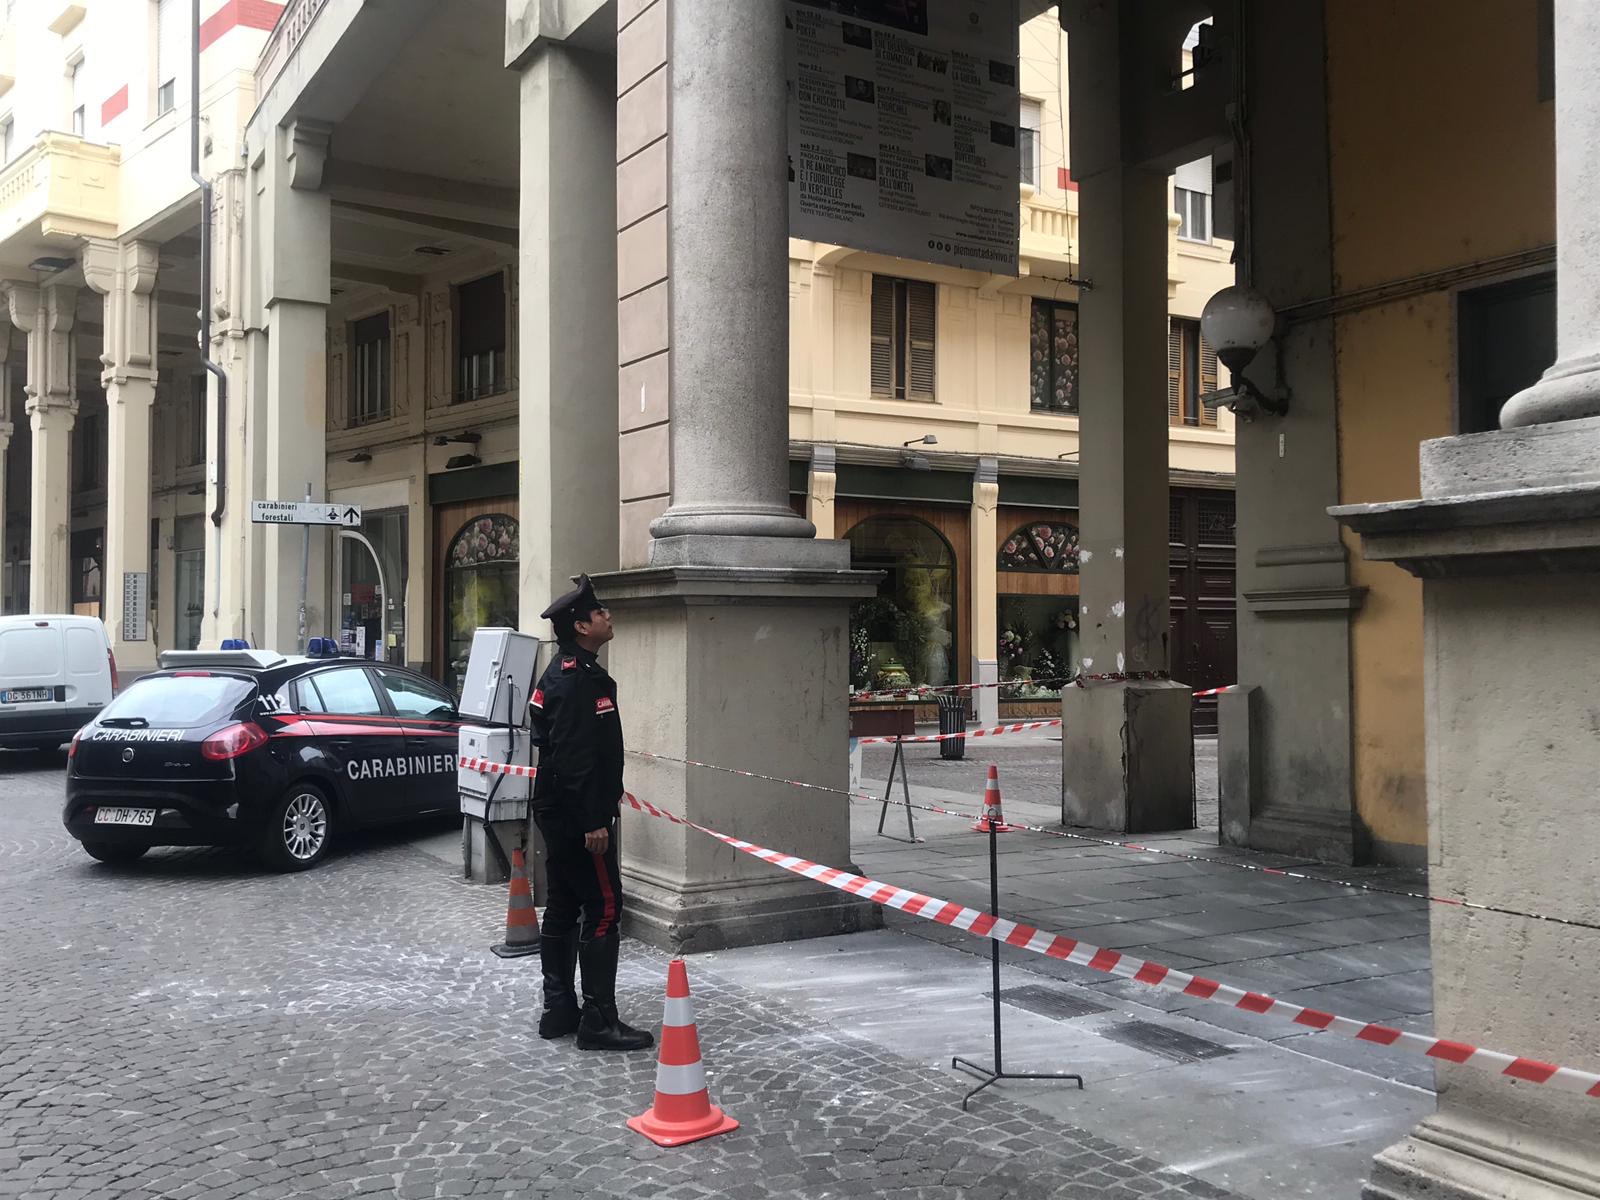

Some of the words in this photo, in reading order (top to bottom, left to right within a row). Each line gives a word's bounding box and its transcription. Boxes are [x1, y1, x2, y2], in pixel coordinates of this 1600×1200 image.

[814, 161, 847, 177] ANARCHICO
[809, 171, 846, 188] FUORILEGGE
[808, 183, 843, 200] VERSAILLES
[257, 502, 298, 511] carabinieri
[261, 512, 294, 522] forestali
[257, 694, 287, 711] 112
[92, 728, 185, 743] CARABINIERI
[347, 754, 459, 780] CARABINIERI
